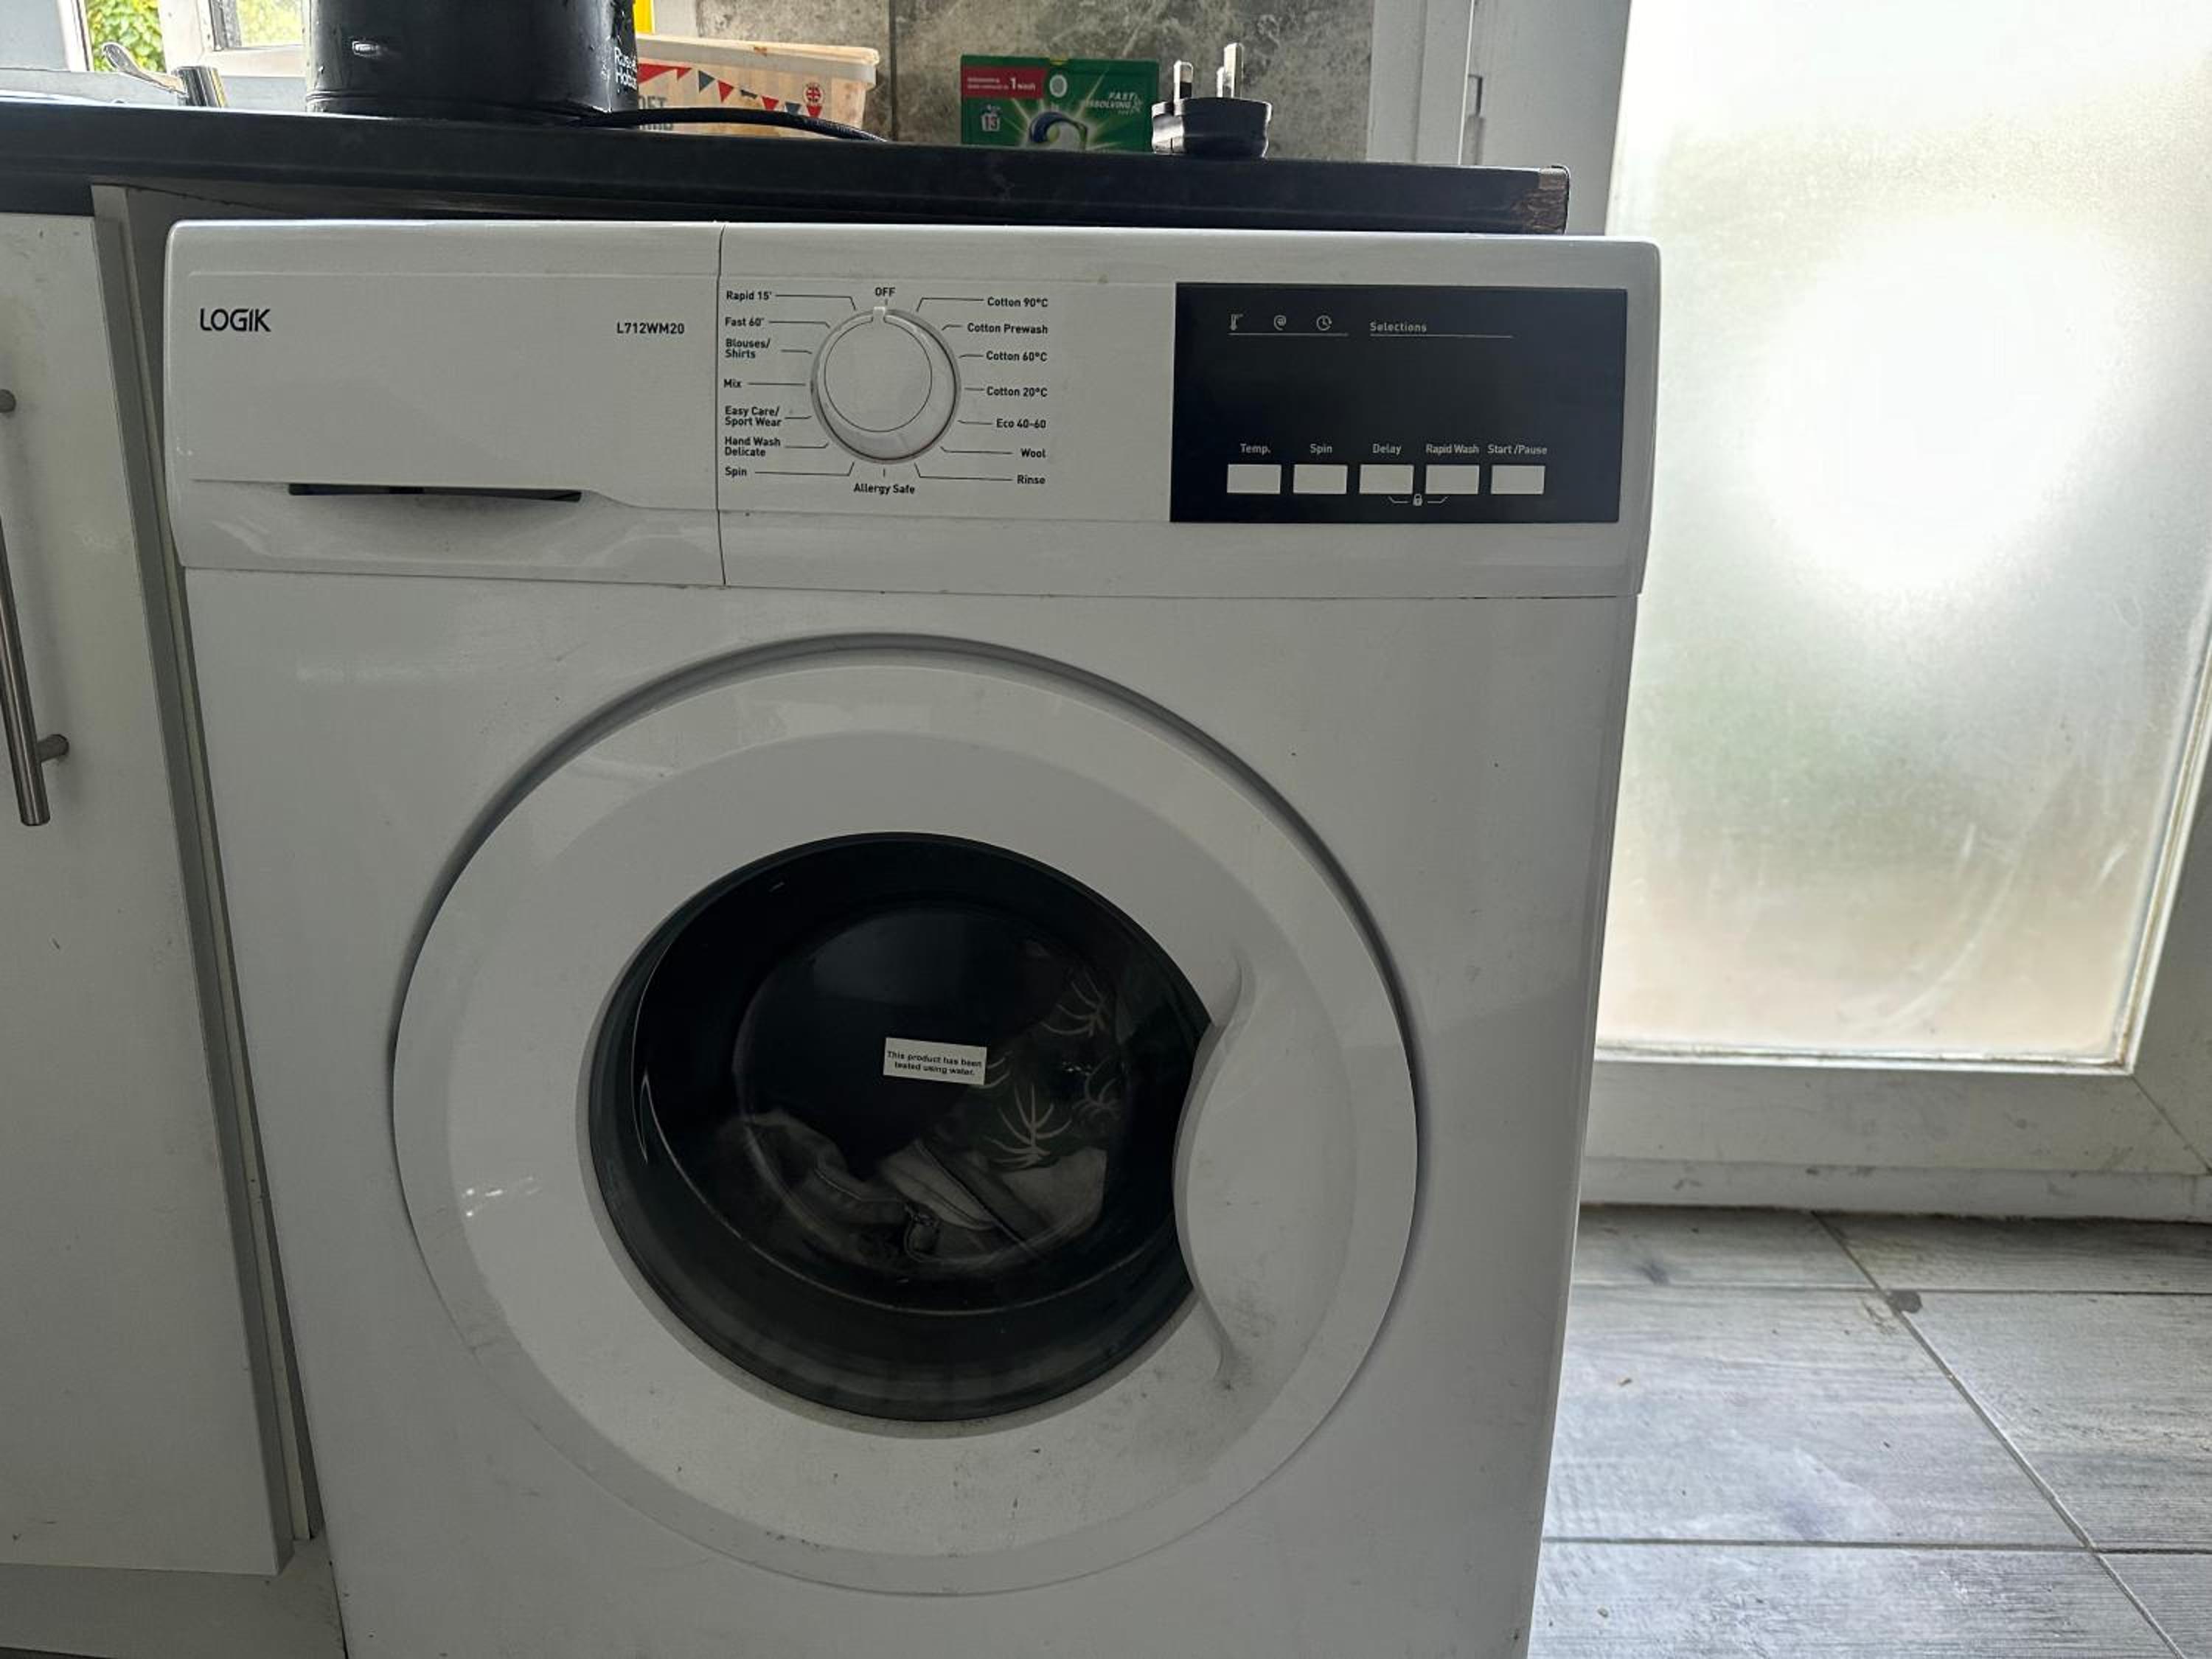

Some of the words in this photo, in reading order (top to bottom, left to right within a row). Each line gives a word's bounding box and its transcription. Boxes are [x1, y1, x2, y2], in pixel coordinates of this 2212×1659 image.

[726, 291, 754, 302] Rapid
[875, 287, 896, 296] OFF
[987, 296, 1021, 307] Cotton
[1023, 297, 1048, 307] 90°C
[200, 308, 271, 332] LOGIK
[725, 316, 746, 327] Fast
[616, 321, 684, 334] L712WM20
[967, 323, 1001, 333] Cotton
[1004, 324, 1048, 334] Prewash
[1369, 321, 1427, 333] Selections
[726, 338, 771, 348] Blouses/
[725, 348, 756, 358] Shirts
[986, 351, 1020, 361] Cotton
[1023, 352, 1048, 361] 60°C
[724, 380, 742, 389] Mix
[987, 386, 1020, 396] Cotton
[1023, 387, 1048, 397] 20°C
[725, 406, 749, 417] Easy
[751, 406, 780, 417] Care/
[725, 416, 752, 427] Sport
[755, 417, 782, 427] Wear
[996, 419, 1015, 428] Eco
[1017, 419, 1046, 428] 40-60
[725, 437, 751, 446] Hand
[753, 437, 781, 447] Wash
[725, 447, 766, 456] Delicate
[1020, 448, 1046, 459] Wool
[1240, 443, 1271, 456] Temp.
[1310, 443, 1332, 455] Spin
[1372, 443, 1402, 455] Delay
[1425, 444, 1453, 456] Rapid
[1453, 444, 1480, 453] Wash
[725, 467, 747, 478] Spin
[1017, 475, 1046, 484] Rinse
[853, 483, 891, 495] Allergy
[893, 484, 915, 495] Safe
[887, 1051, 905, 1060] This
[908, 1054, 942, 1064] product
[943, 1057, 959, 1065] has
[961, 1059, 981, 1068] been
[894, 1062, 921, 1071] tested
[922, 1065, 947, 1074] using
